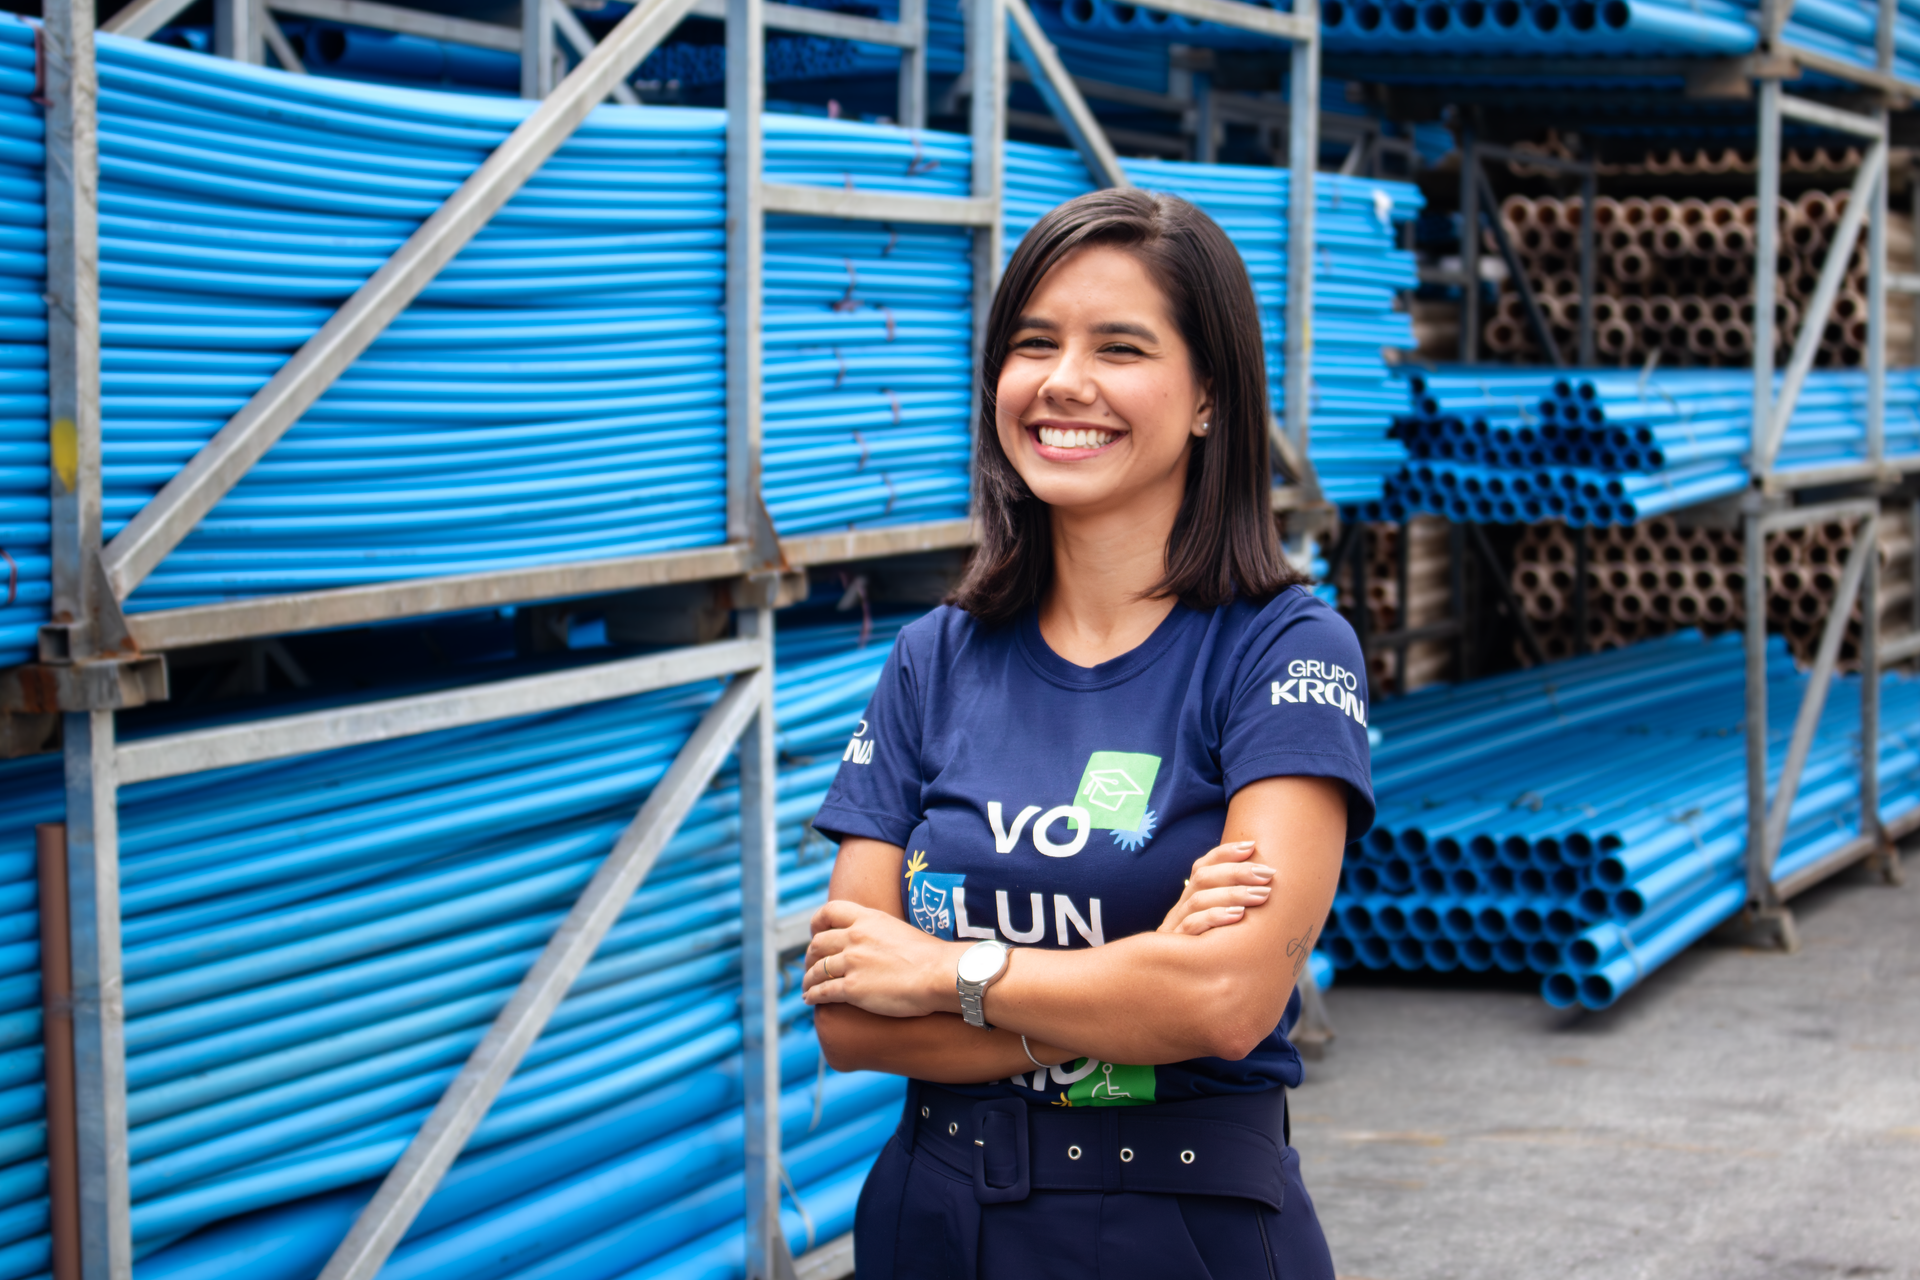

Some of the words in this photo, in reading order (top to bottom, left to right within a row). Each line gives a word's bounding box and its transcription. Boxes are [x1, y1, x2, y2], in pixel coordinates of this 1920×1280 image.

[1288, 659, 1357, 691] GRUPO
[1271, 678, 1367, 728] KRON
[987, 801, 1091, 858] VO
[952, 886, 1105, 948] LUN
